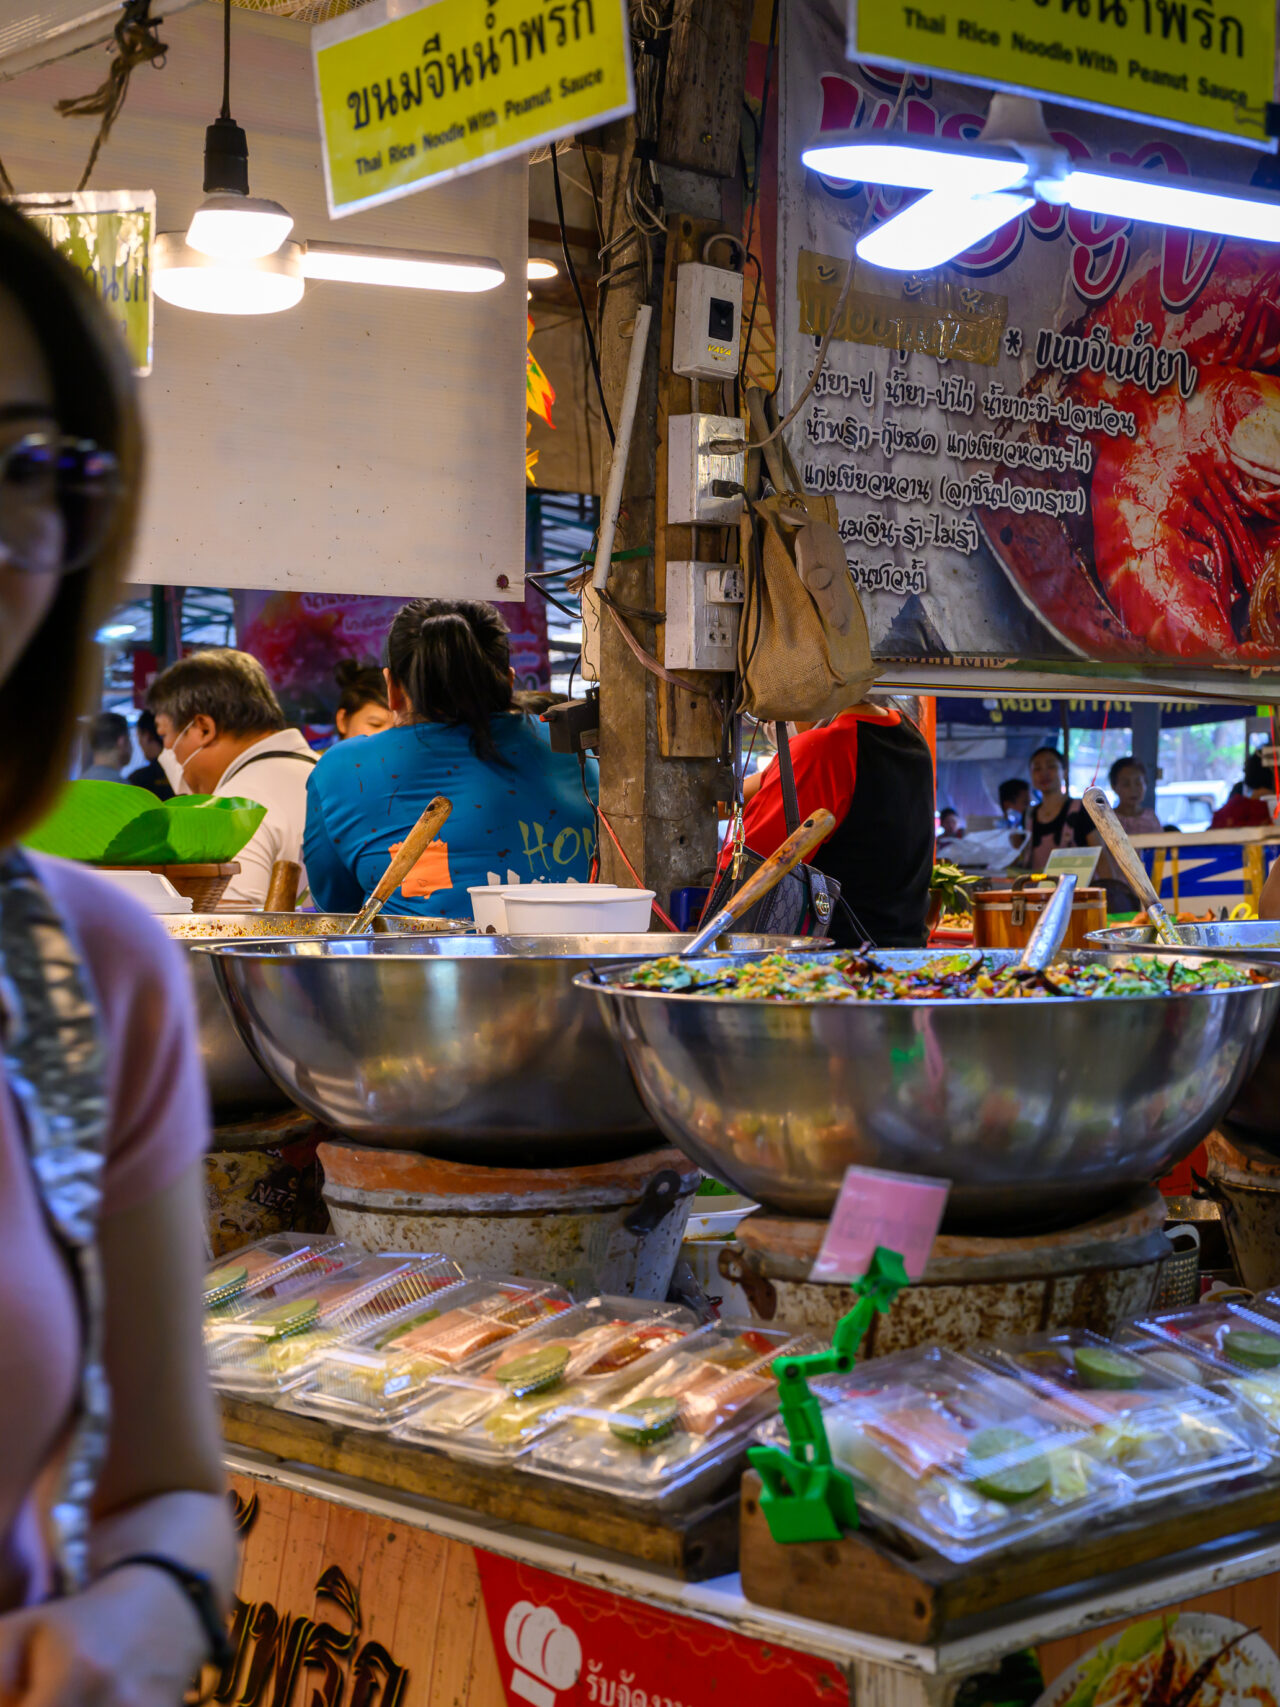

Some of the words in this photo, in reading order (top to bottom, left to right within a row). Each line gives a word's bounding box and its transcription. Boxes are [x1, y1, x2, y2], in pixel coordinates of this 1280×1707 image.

[904, 7, 947, 37] Thai
[957, 17, 1001, 47] Rice
[1128, 60, 1190, 94] Peanut
[1197, 76, 1248, 107] Sauce
[355, 151, 383, 177] Thai
[389, 141, 417, 166] Rice
[503, 86, 553, 121] Peanut
[558, 67, 605, 99] Sauce
[1036, 322, 1197, 396] ขนมจีนน้ำยา
